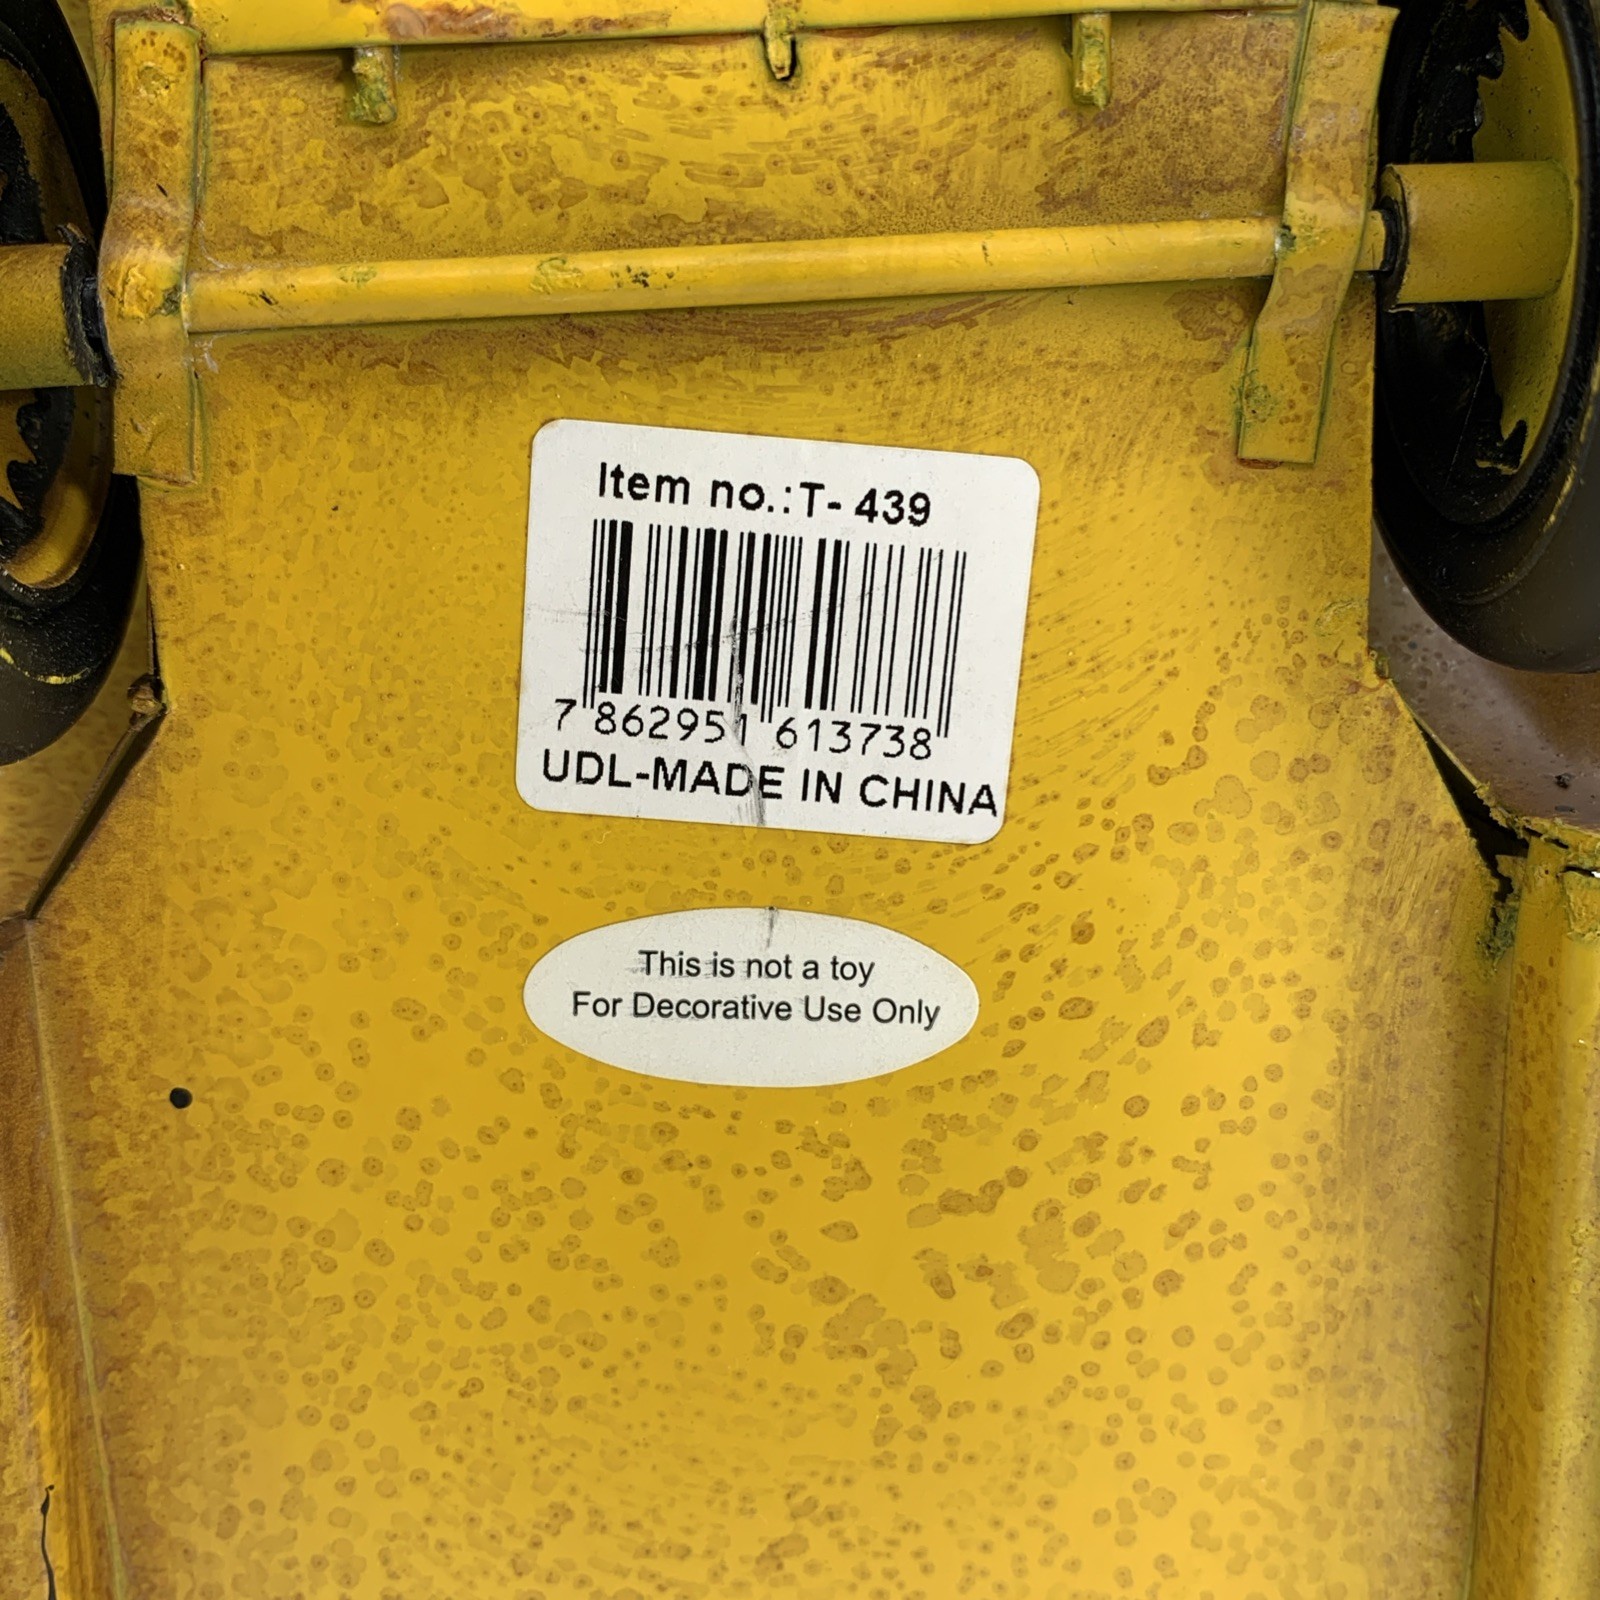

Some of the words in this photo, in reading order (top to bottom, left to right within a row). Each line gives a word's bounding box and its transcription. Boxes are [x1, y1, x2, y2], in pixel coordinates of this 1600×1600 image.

[600, 462, 689, 505] Item
[855, 488, 931, 526] 439
[555, 699, 577, 731] 7
[595, 703, 748, 747] 862951
[776, 717, 932, 761] 613738
[542, 749, 784, 799] UDL-MADE
[802, 769, 842, 804] IN
[860, 775, 998, 817] CHINA
[639, 950, 700, 977] This
[712, 951, 734, 977] is
[746, 954, 792, 980] not
[802, 960, 819, 980] a
[830, 956, 875, 987] toy
[572, 991, 622, 1017] For
[633, 992, 793, 1021] Decorative
[804, 996, 861, 1023] Use
[873, 998, 941, 1031] Only
